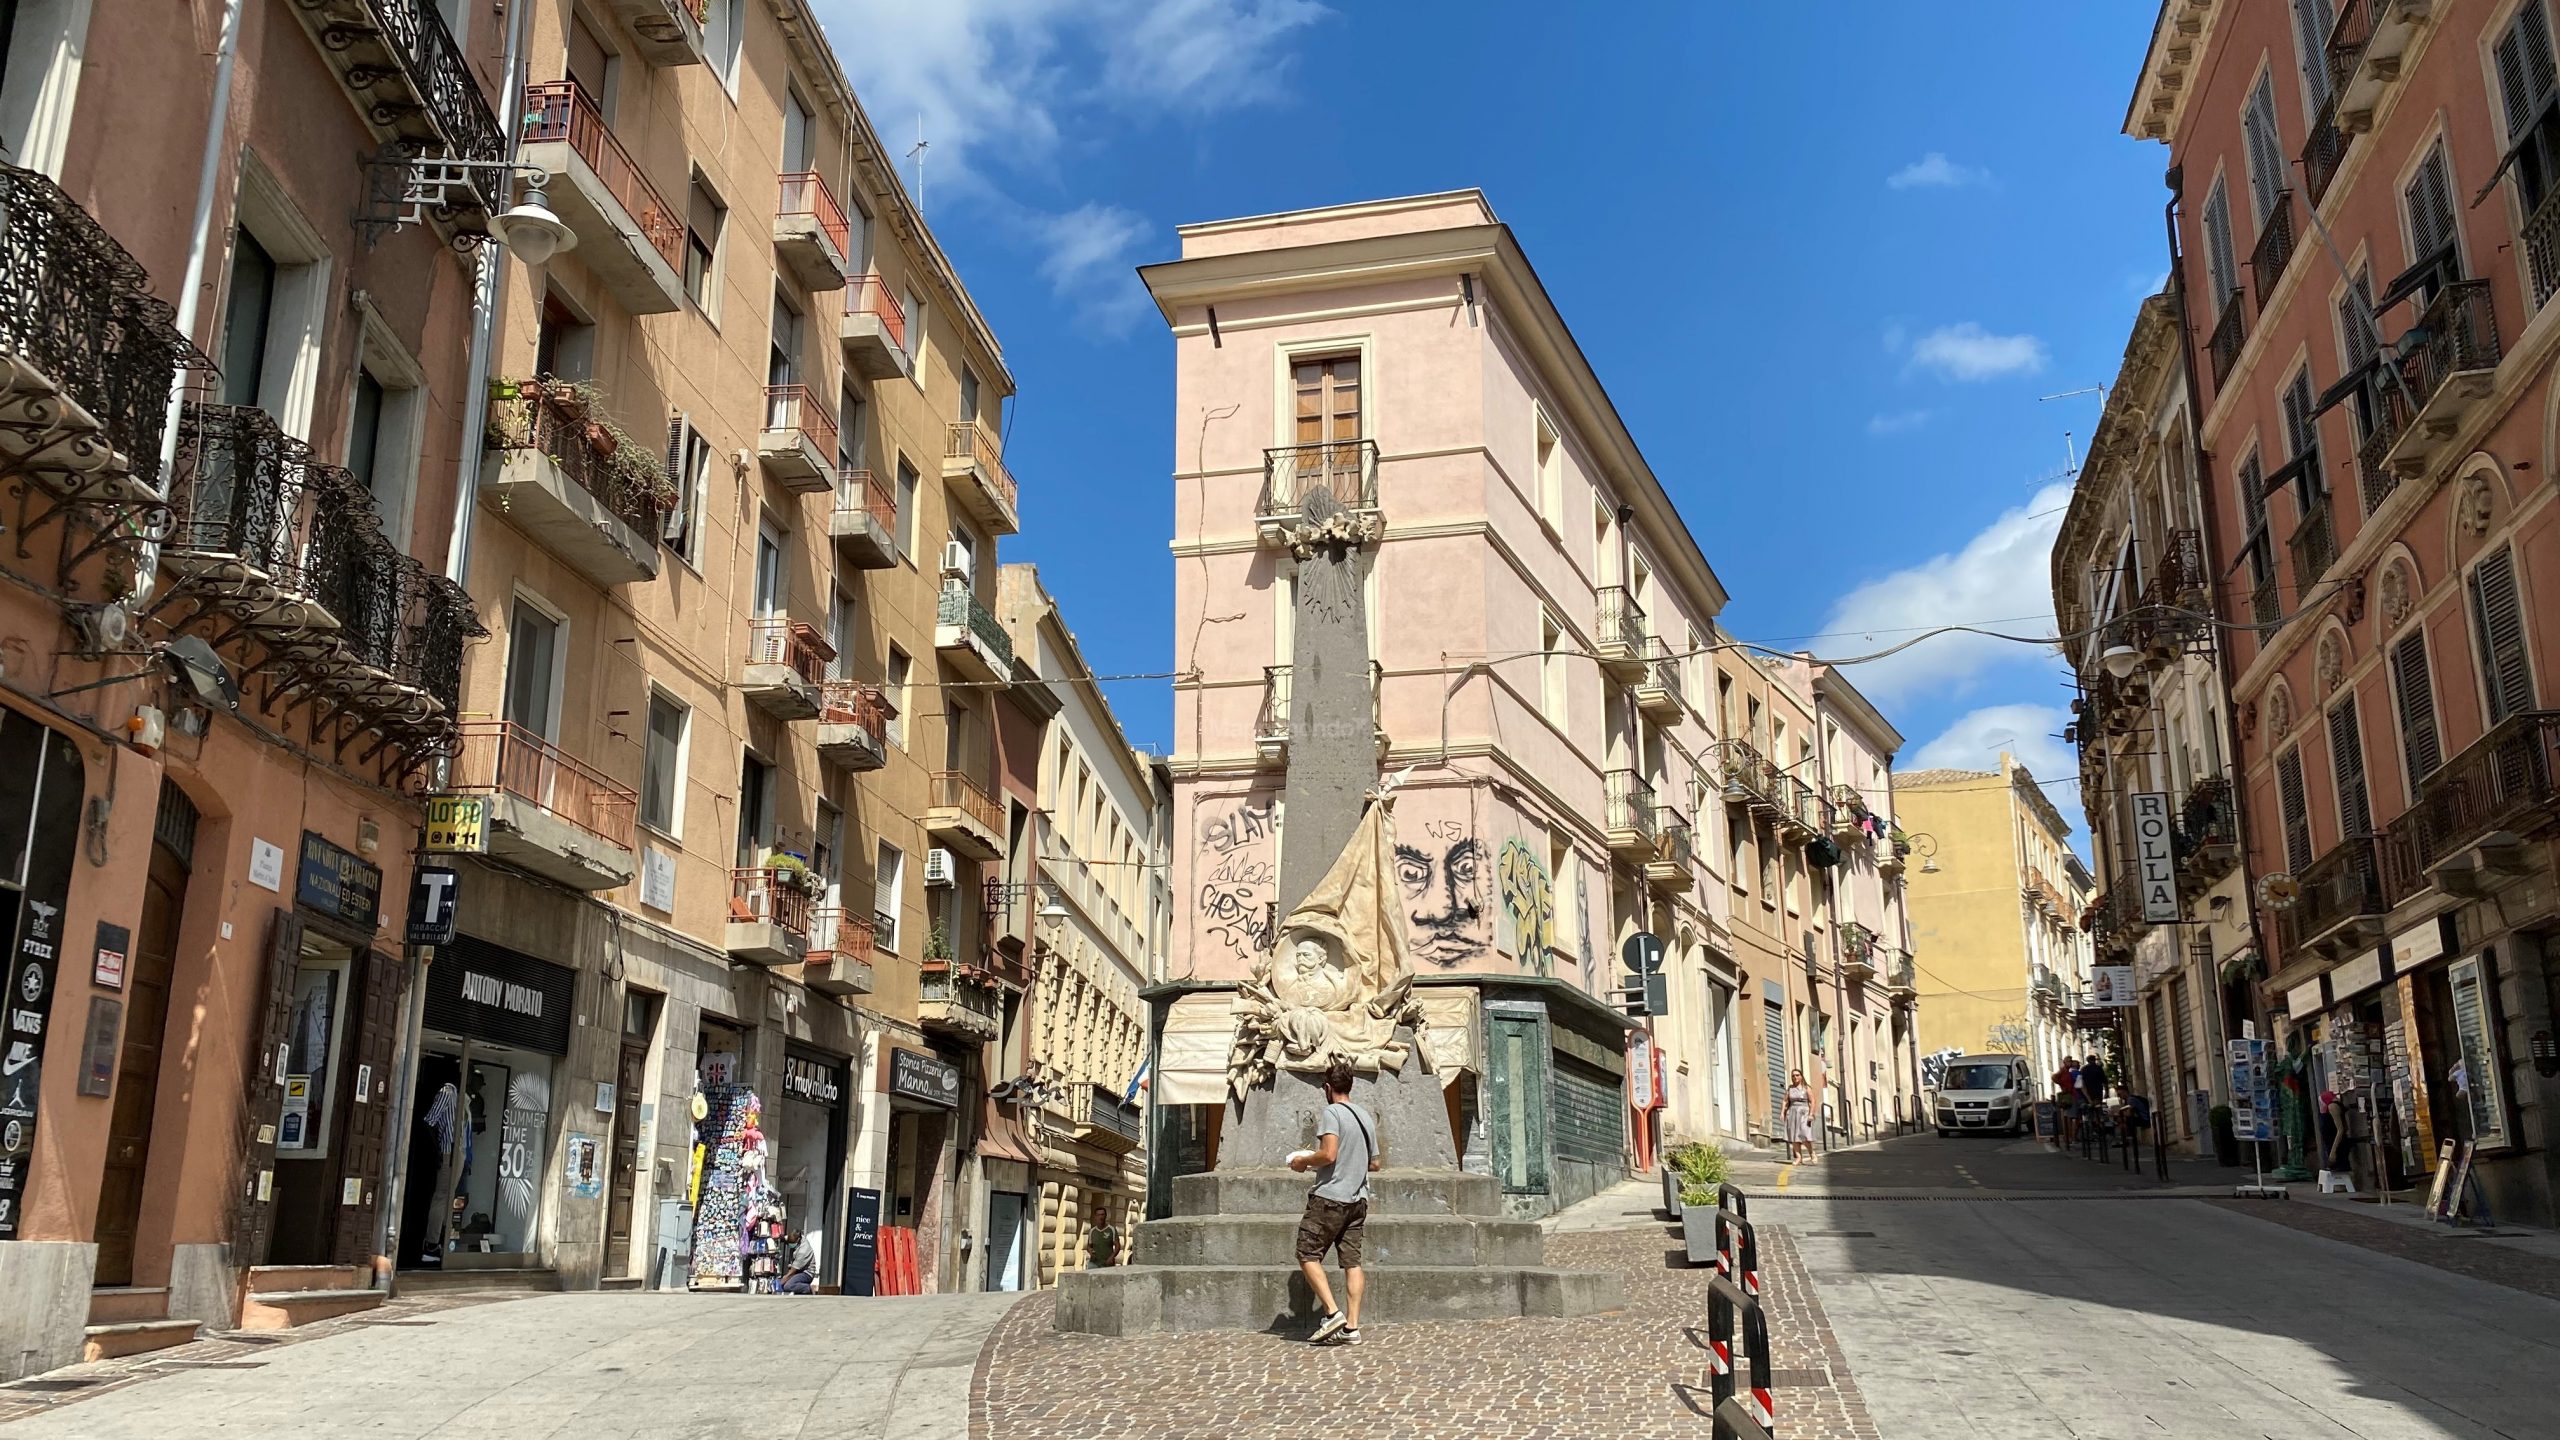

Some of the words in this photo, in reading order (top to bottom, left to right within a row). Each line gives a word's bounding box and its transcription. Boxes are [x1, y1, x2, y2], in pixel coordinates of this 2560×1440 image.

[430, 801, 483, 824] LOTTO
[462, 832, 477, 845] 11
[2139, 797, 2172, 904] ROLLA
[309, 872, 341, 898] NAZIONALI
[341, 887, 351, 902] ED
[351, 892, 372, 912] ESTERI
[421, 873, 454, 923] T
[22, 938, 53, 959] PYREX
[504, 982, 543, 1018] MORATO
[12, 1008, 43, 1035] VANS
[899, 1052, 920, 1072] Storica
[921, 1059, 942, 1078] Pizzeria
[898, 1068, 929, 1094] Manno
[0, 1106, 34, 1118] JORDAN
[503, 1109, 547, 1129] SUMMER
[502, 1126, 528, 1143] TIME
[855, 1215, 871, 1224] nice
[855, 1223, 862, 1231] &
[853, 1231, 873, 1240] price
